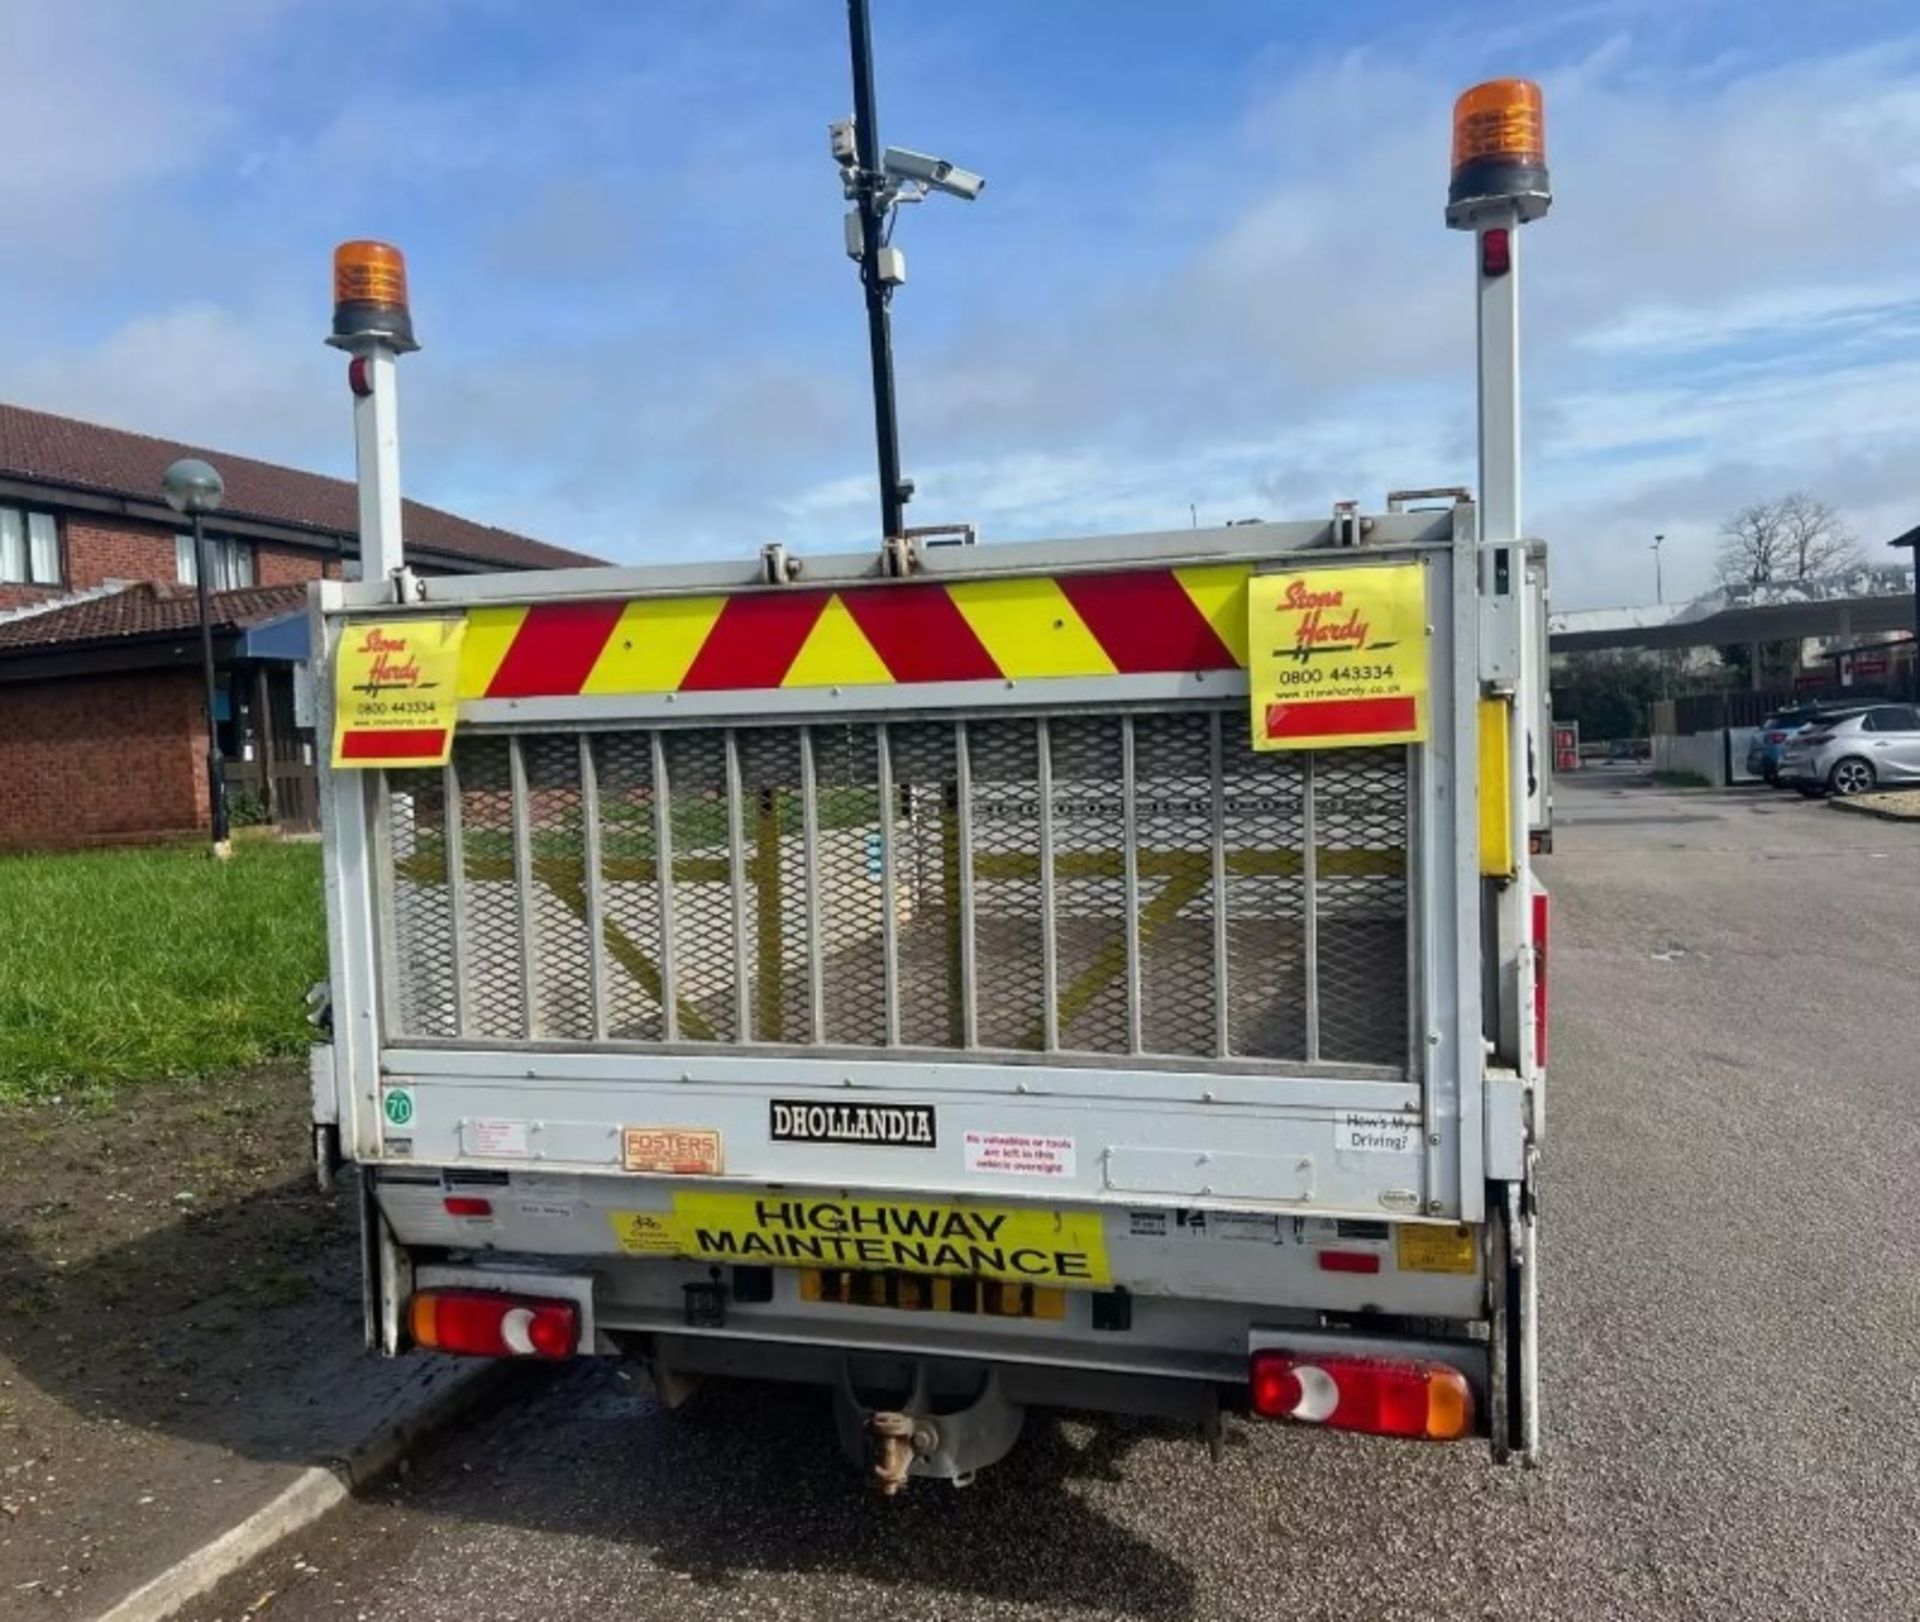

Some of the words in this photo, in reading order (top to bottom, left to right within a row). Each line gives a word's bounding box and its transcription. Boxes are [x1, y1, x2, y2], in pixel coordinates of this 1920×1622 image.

[1275, 581, 1343, 611] Stone
[1295, 608, 1369, 650] Hardy
[369, 653, 421, 690] Hardy
[1280, 669, 1322, 685] 0800
[1331, 665, 1394, 681] 443334
[357, 702, 387, 716] 0800
[392, 701, 436, 714] 443334
[387, 1099, 411, 1122] 70
[773, 1105, 932, 1142] DHOLLANDIA
[1346, 1113, 1388, 1129] How's
[627, 1134, 716, 1151] FOSTERS
[1351, 1132, 1409, 1152] Driving?
[755, 1200, 1007, 1243] HIGHWAY
[694, 1228, 1093, 1280] MAINTENANCE
